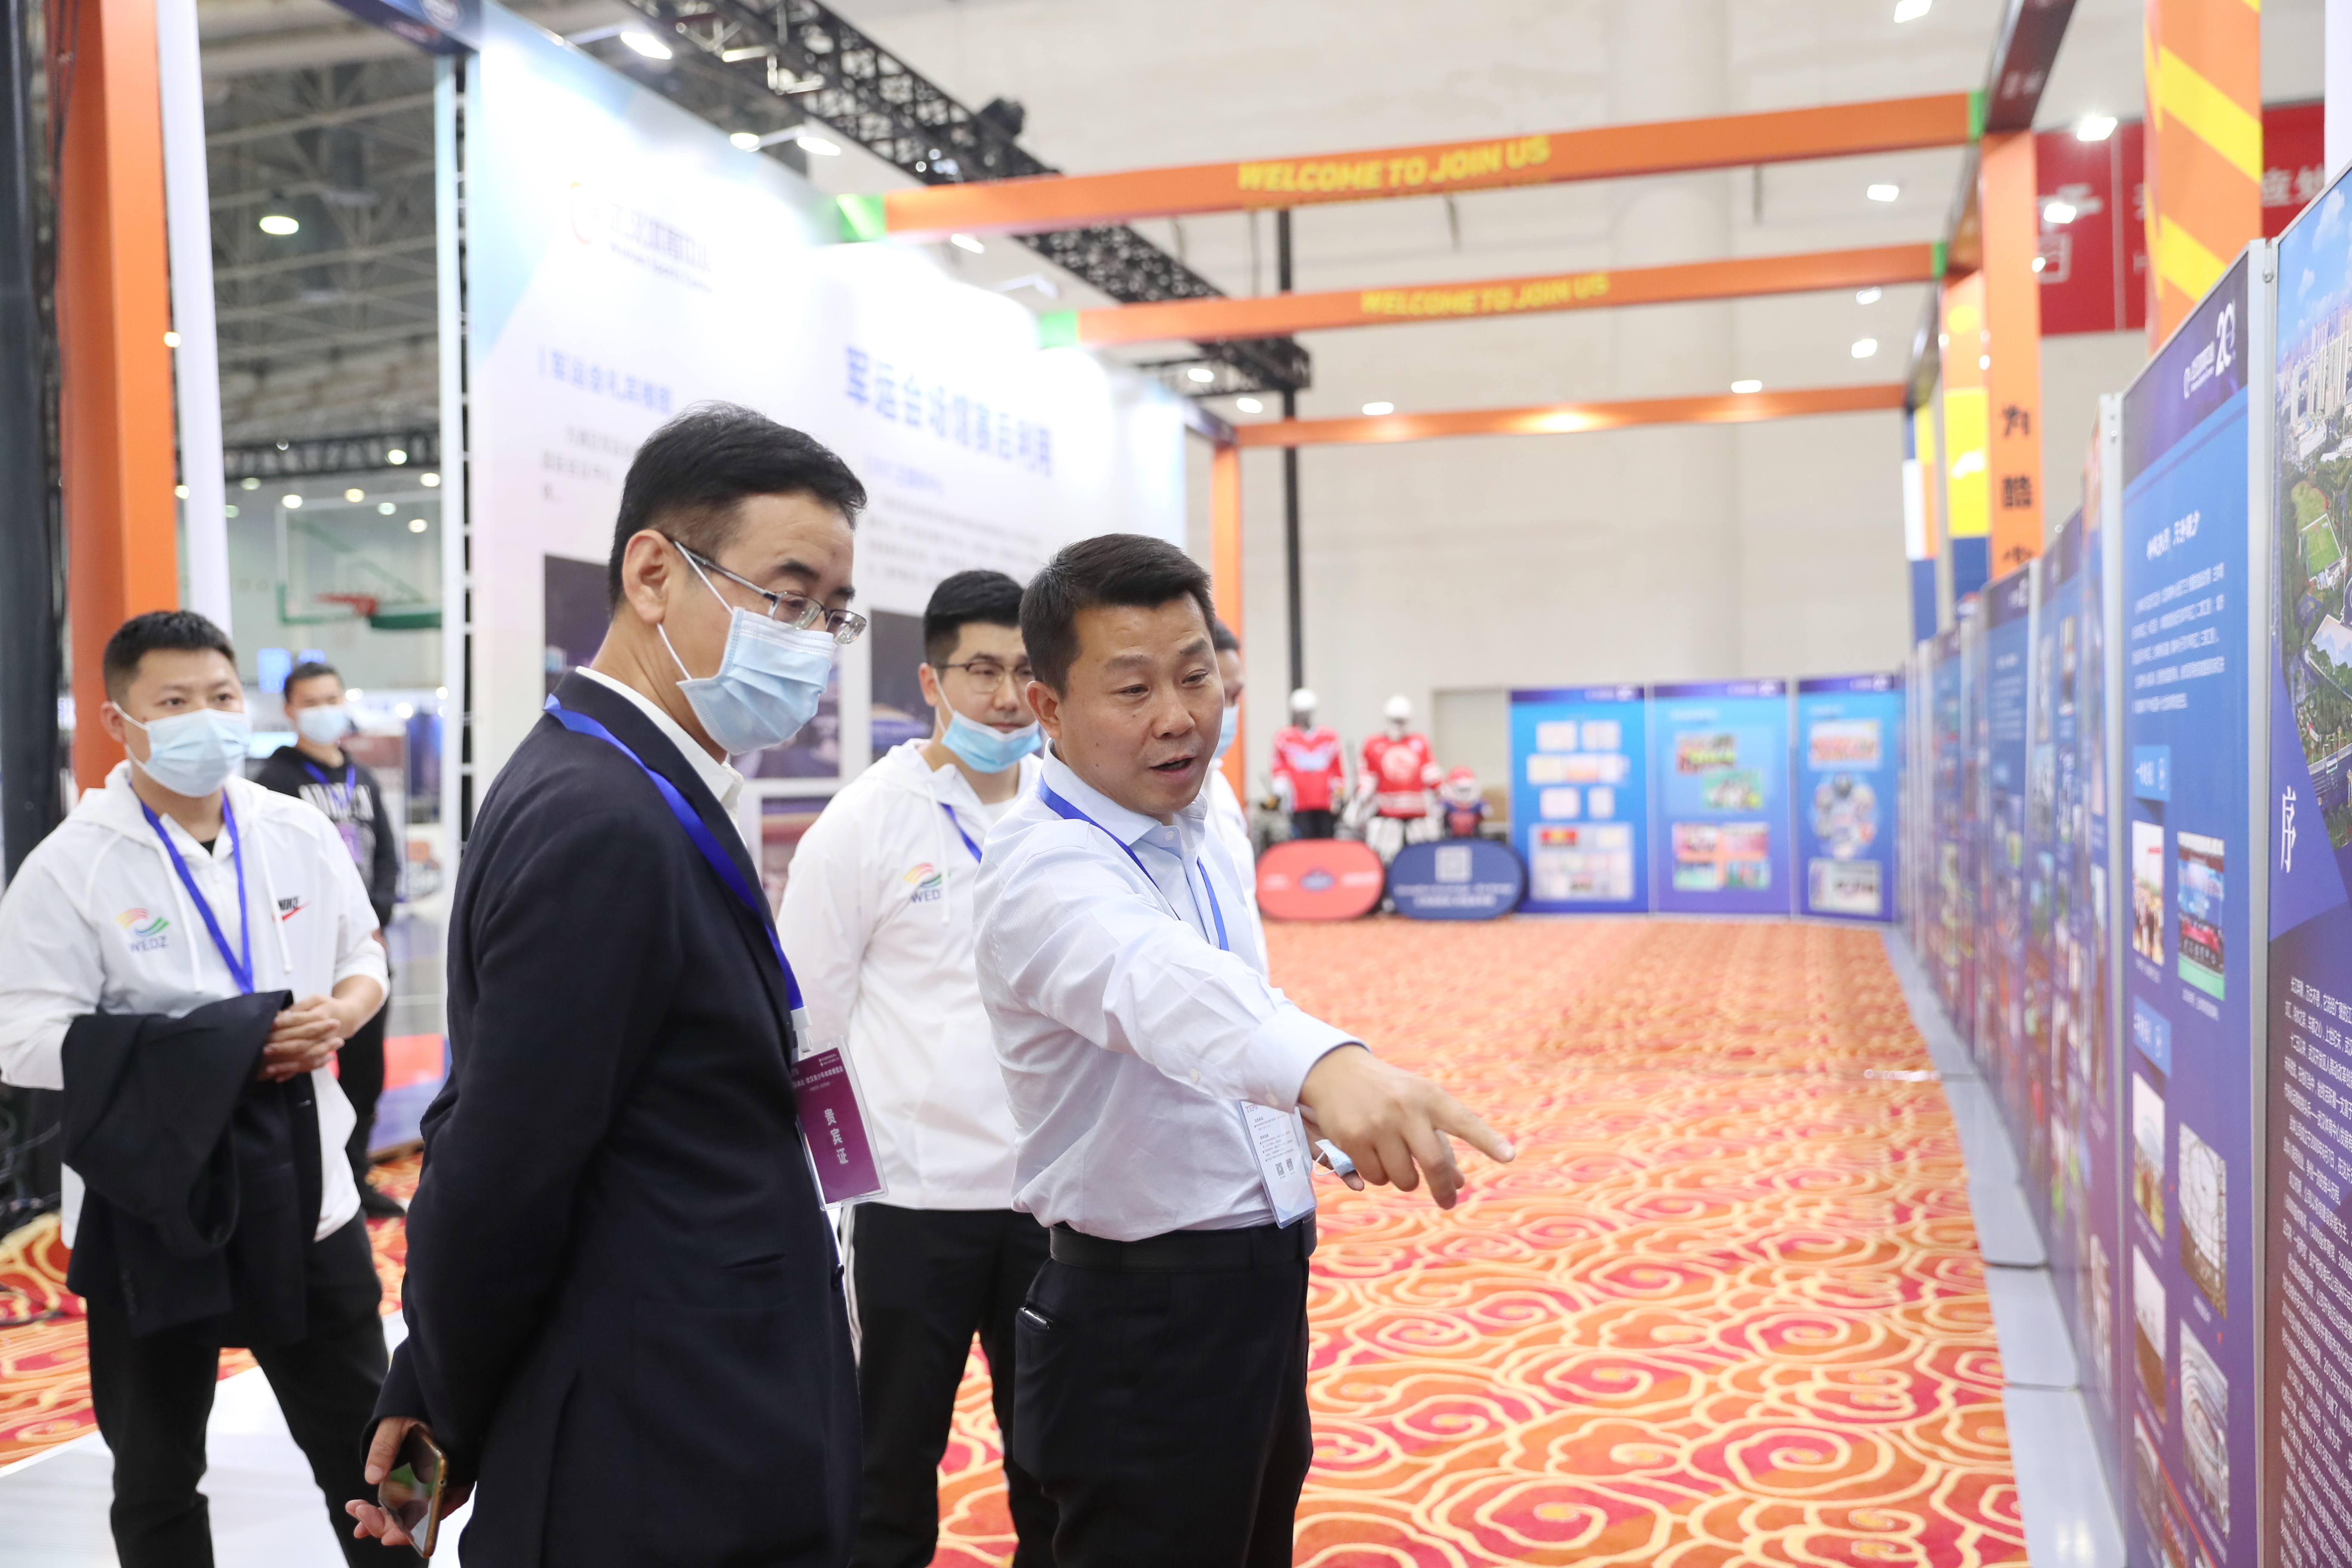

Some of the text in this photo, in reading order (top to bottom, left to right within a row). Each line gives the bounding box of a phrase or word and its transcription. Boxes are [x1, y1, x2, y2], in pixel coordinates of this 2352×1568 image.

[1237, 134, 1551, 193] WELCOME TO JOIN US
[1361, 271, 1609, 316] WELCOME TO JOIN US
[2280, 785, 2297, 873] 序
[910, 888, 943, 903] WED
[824, 1108, 848, 1164] 贵宾证
